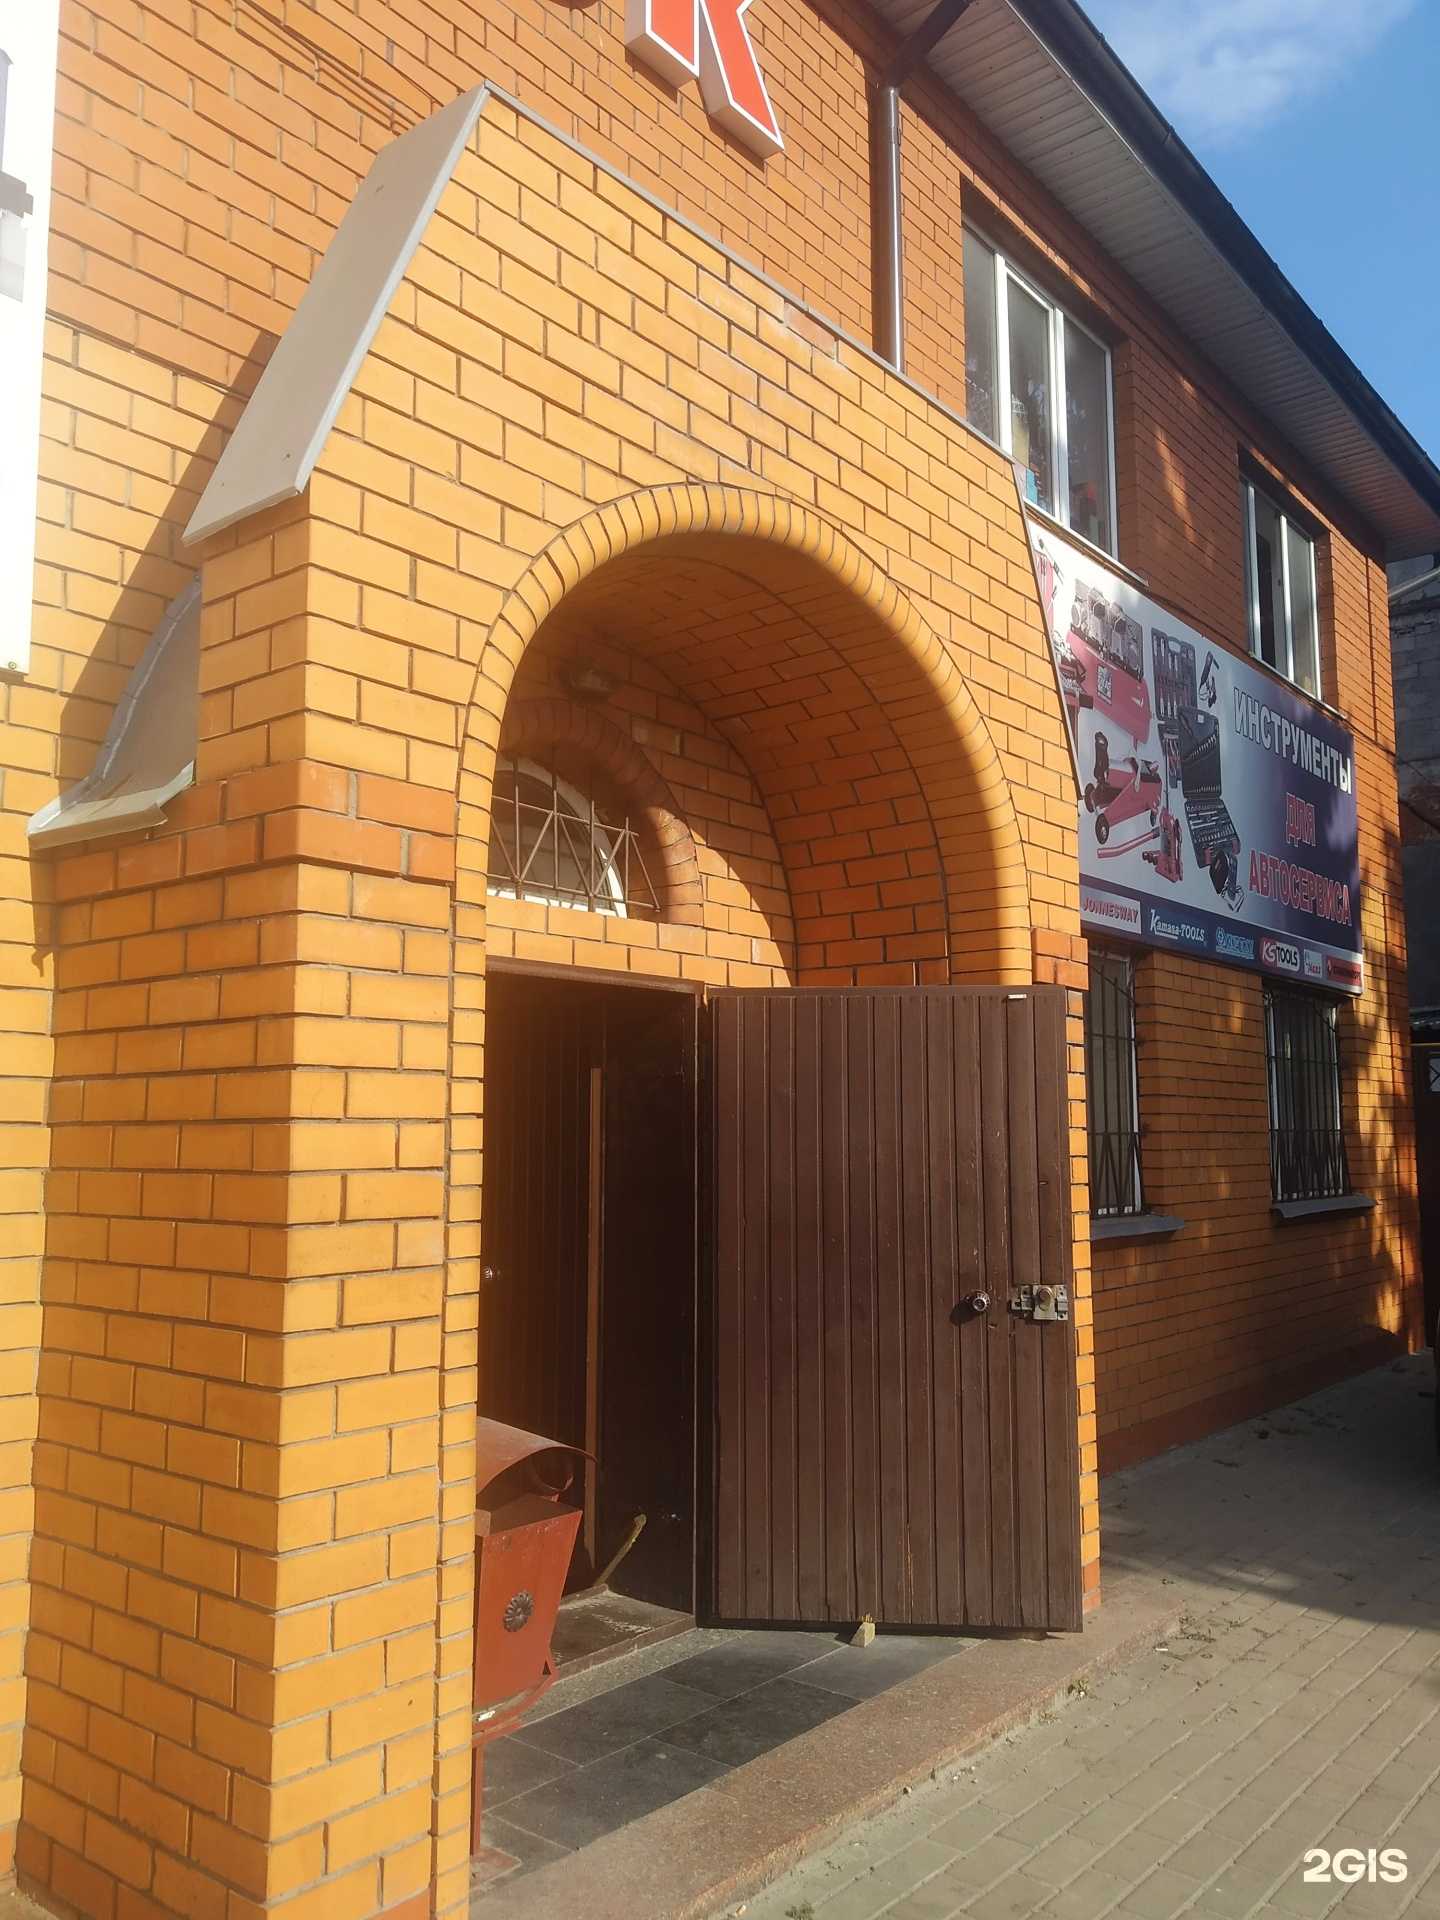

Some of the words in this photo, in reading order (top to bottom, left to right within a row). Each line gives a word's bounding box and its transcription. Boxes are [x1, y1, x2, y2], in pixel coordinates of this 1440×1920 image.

[1233, 686, 1352, 795] ИНСТРУМЕНТЫ
[1285, 791, 1316, 848] ДЛЯ
[1083, 897, 1139, 924] JONNESWAY
[1248, 848, 1353, 927] АВТОСЕРВИСА
[1276, 945, 1299, 967] TOOLS
